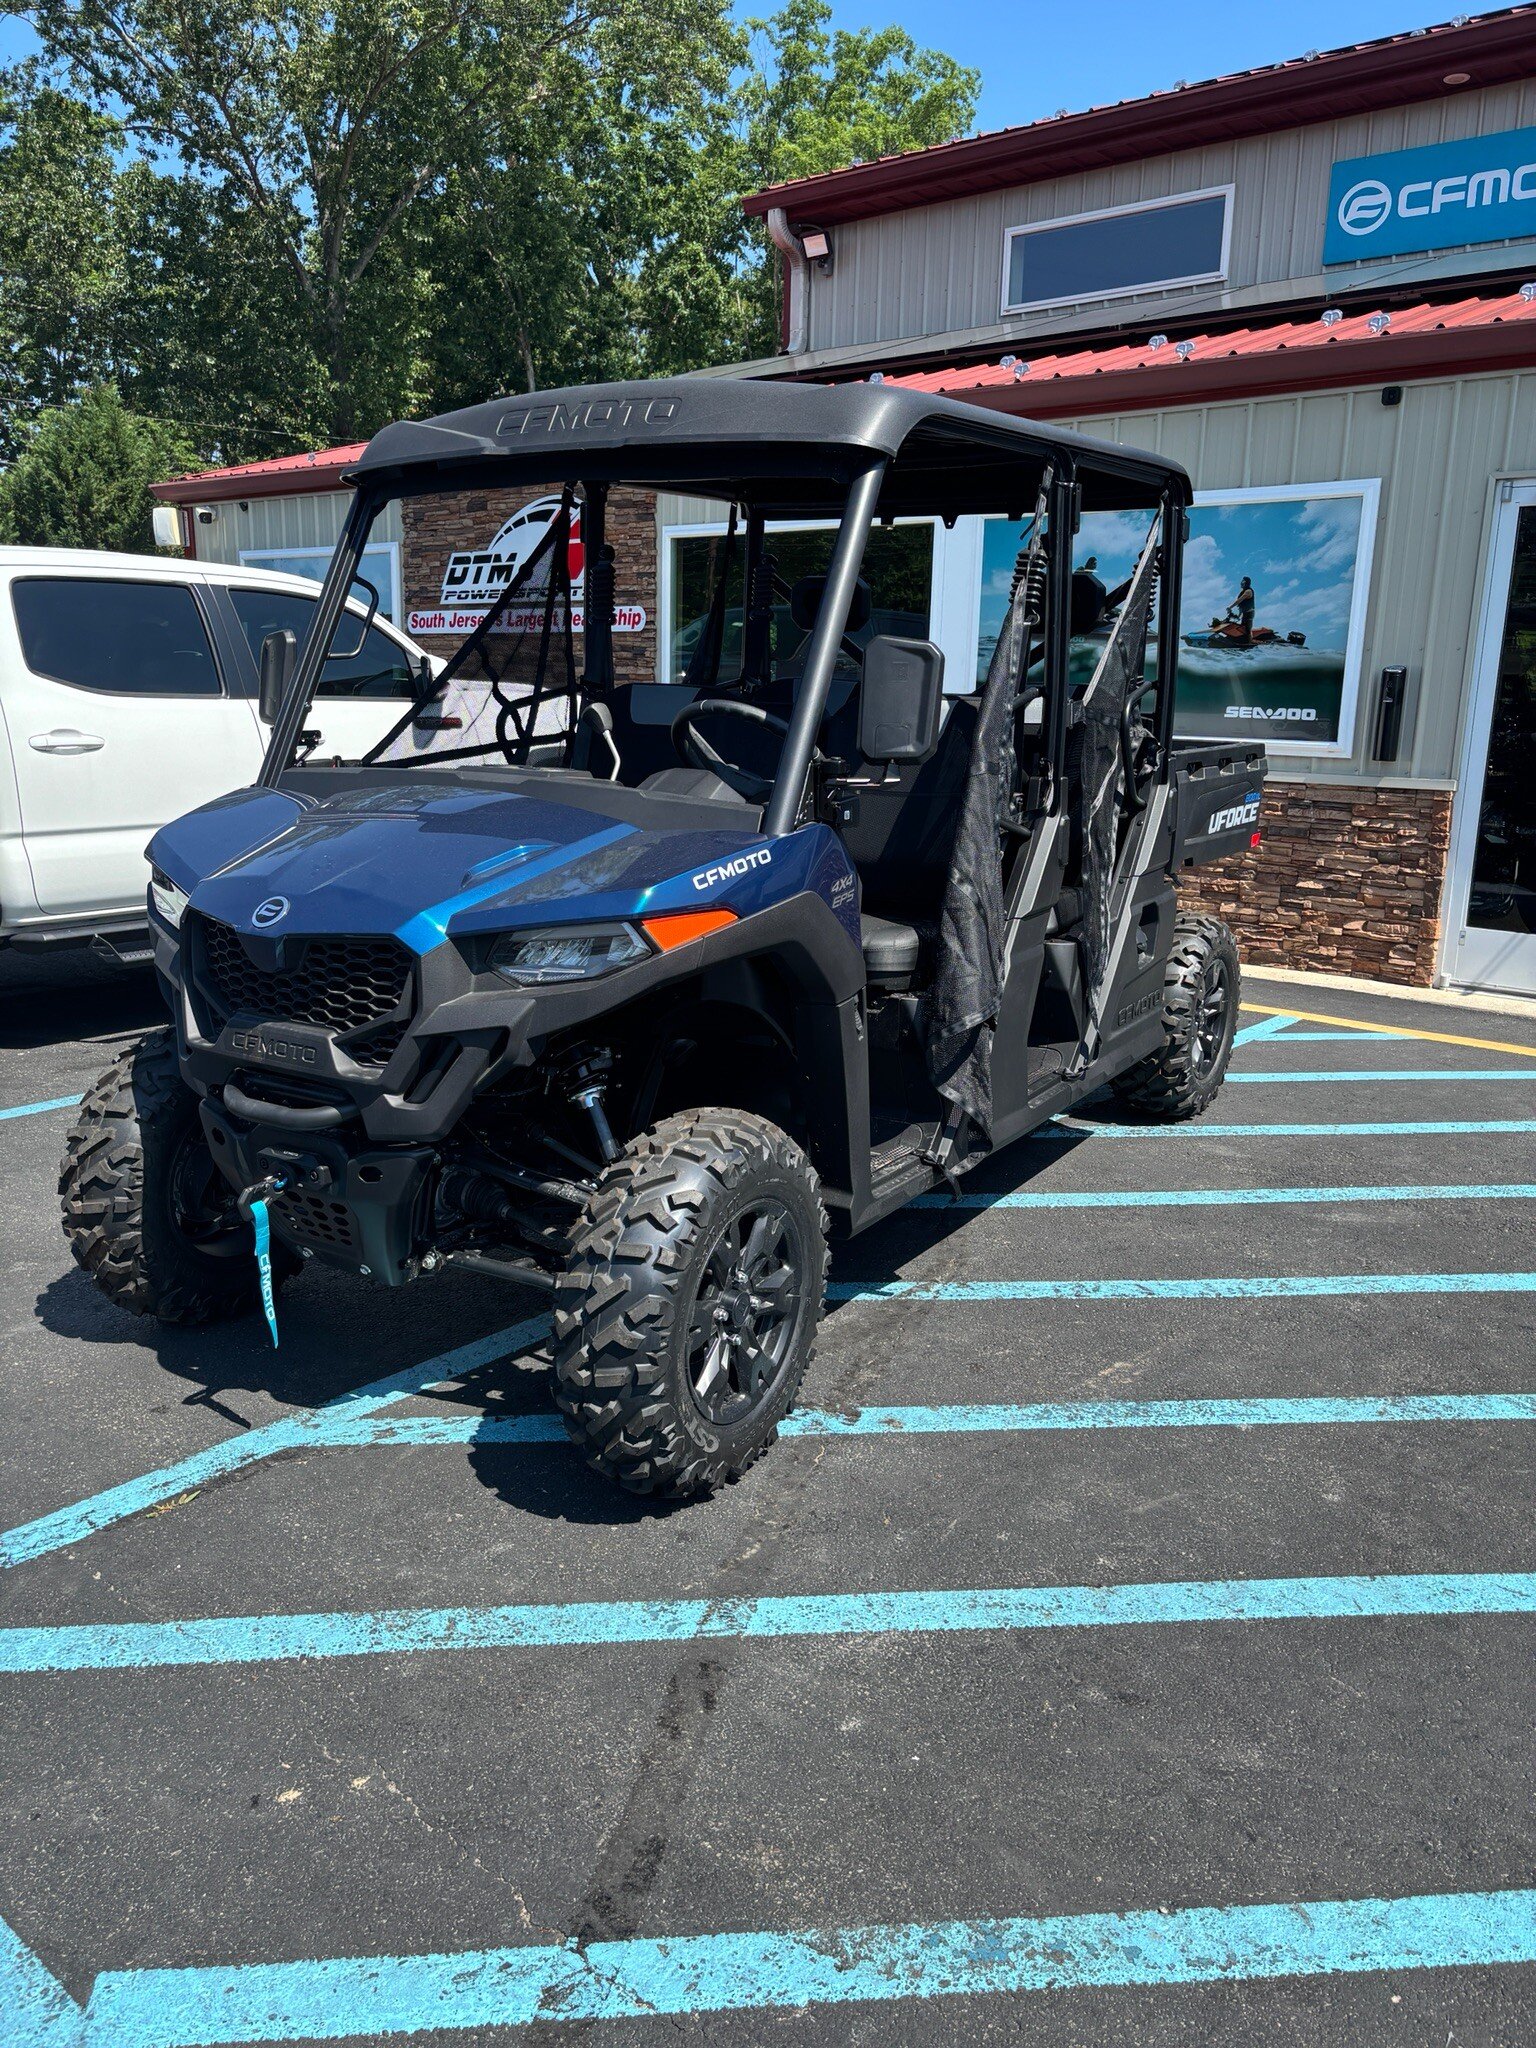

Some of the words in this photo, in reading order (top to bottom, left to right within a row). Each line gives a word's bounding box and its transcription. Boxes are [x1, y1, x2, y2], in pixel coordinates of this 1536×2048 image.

[496, 396, 683, 437] CFMOTO
[446, 552, 518, 586] DTM
[411, 613, 445, 629] South
[449, 612, 503, 628] Jerses
[507, 610, 559, 630] Larget
[1208, 801, 1260, 835] UFORCE
[692, 848, 772, 891] CFMOTO
[831, 874, 853, 894] 4X4
[832, 889, 855, 909] EPS
[232, 1031, 316, 1064] CFMOTO
[260, 1253, 276, 1321] CFMOTO
[685, 1416, 720, 1454] CST
